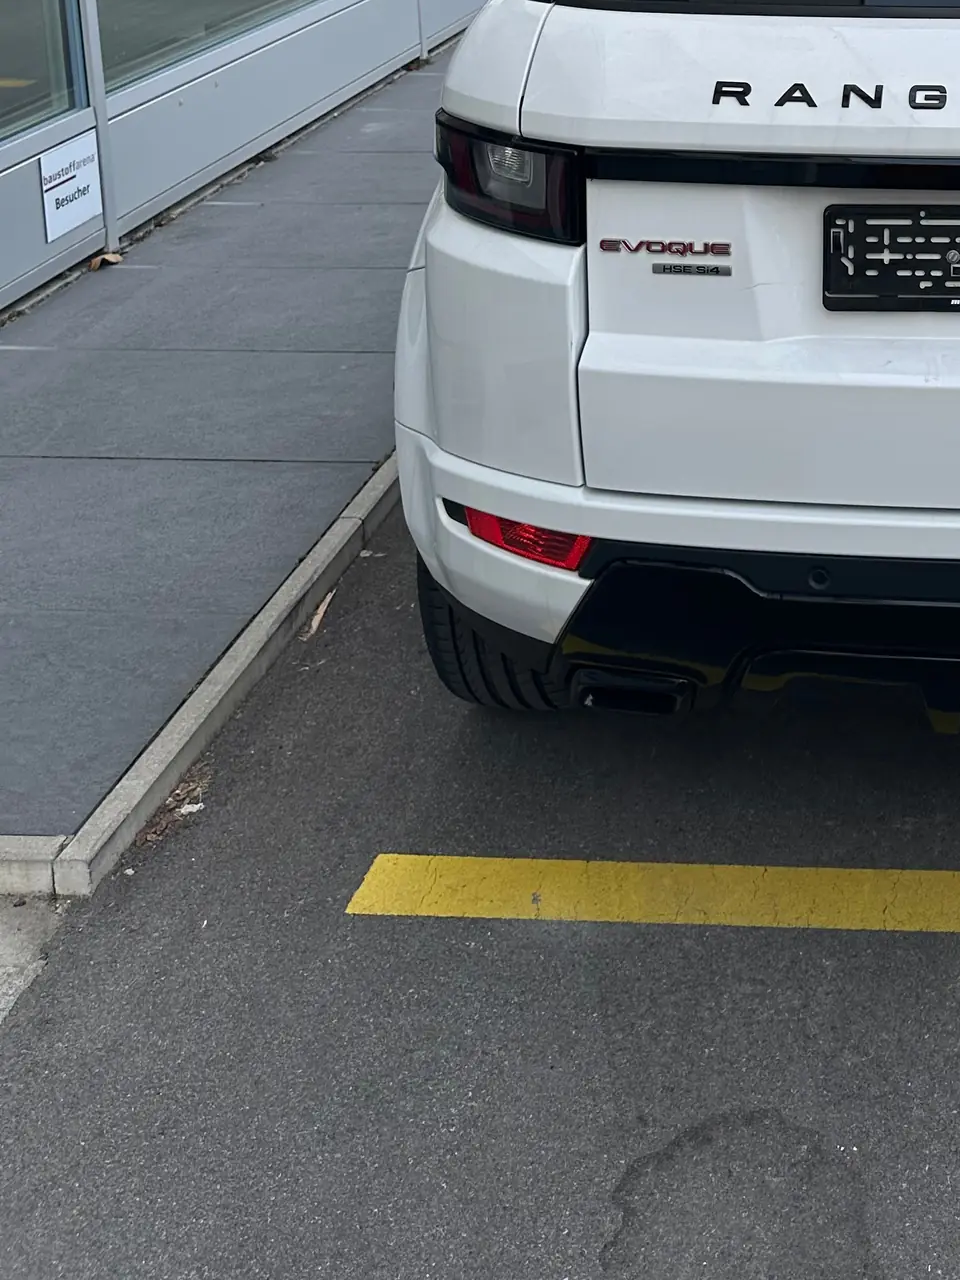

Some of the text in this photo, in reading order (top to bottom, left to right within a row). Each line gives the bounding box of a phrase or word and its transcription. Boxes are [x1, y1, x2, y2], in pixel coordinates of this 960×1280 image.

[42, 153, 95, 185] baustoffarena
[54, 183, 90, 210] Besucher
[599, 239, 731, 256] EVOQUE
[662, 264, 720, 275] HSE Si4
